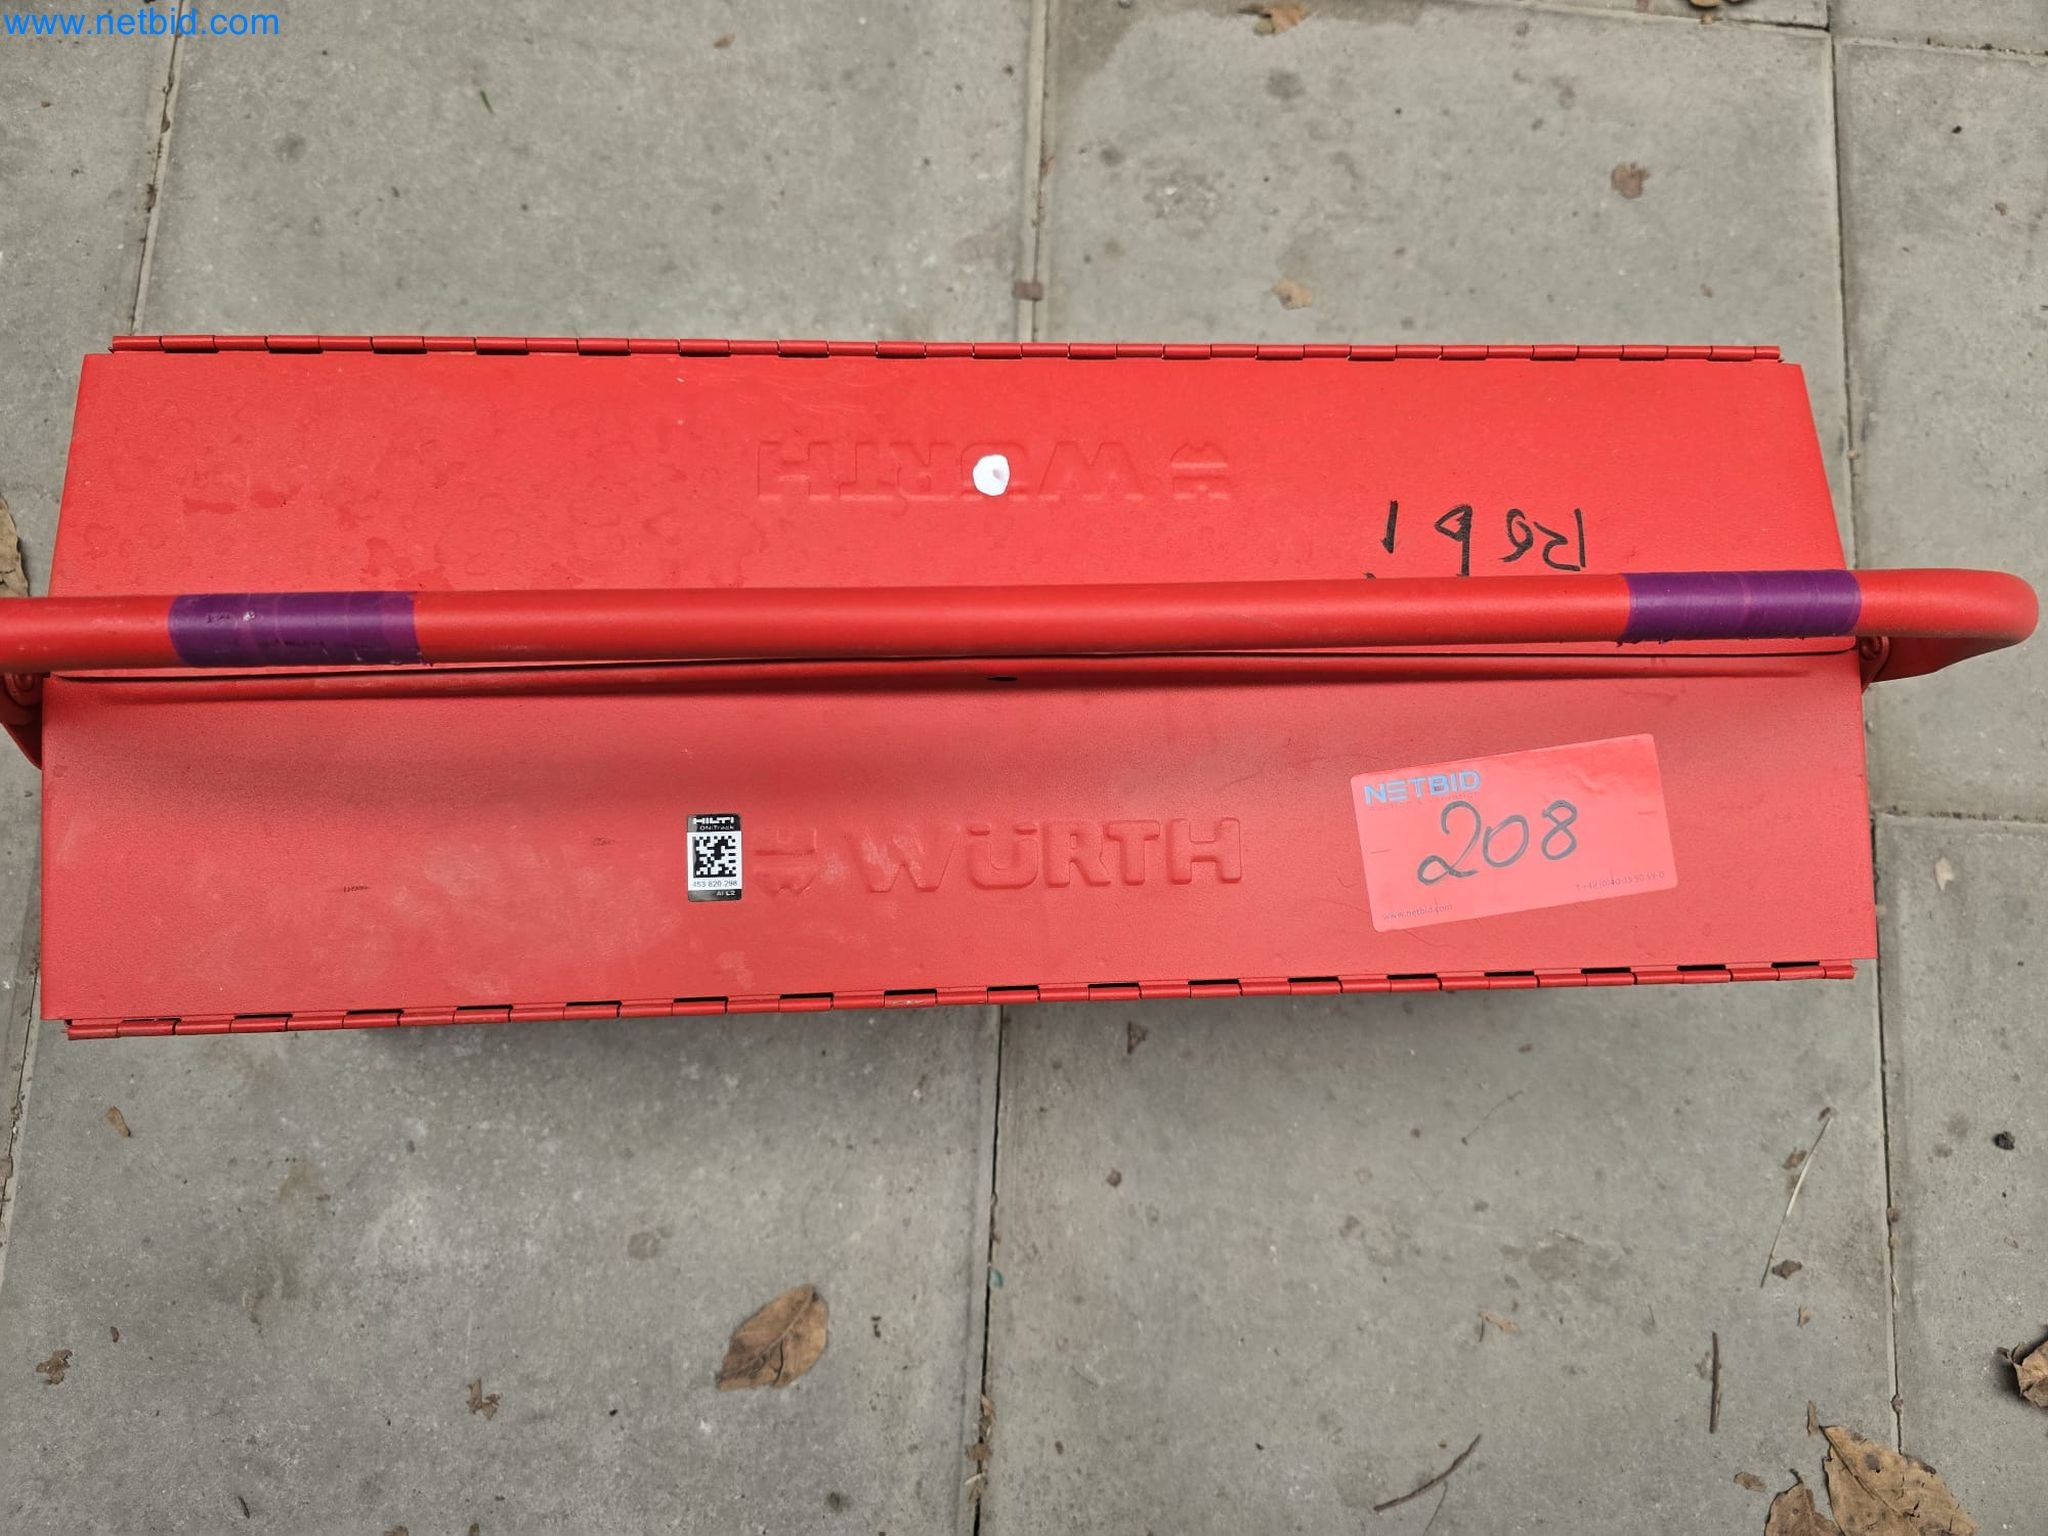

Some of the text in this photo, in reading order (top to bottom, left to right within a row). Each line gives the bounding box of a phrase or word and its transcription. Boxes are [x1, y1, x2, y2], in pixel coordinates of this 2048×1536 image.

[1363, 769, 1482, 805] NETBID
[693, 816, 735, 824] HILTI
[1417, 799, 1579, 886] 208
[844, 817, 1242, 894] WÜRTH
